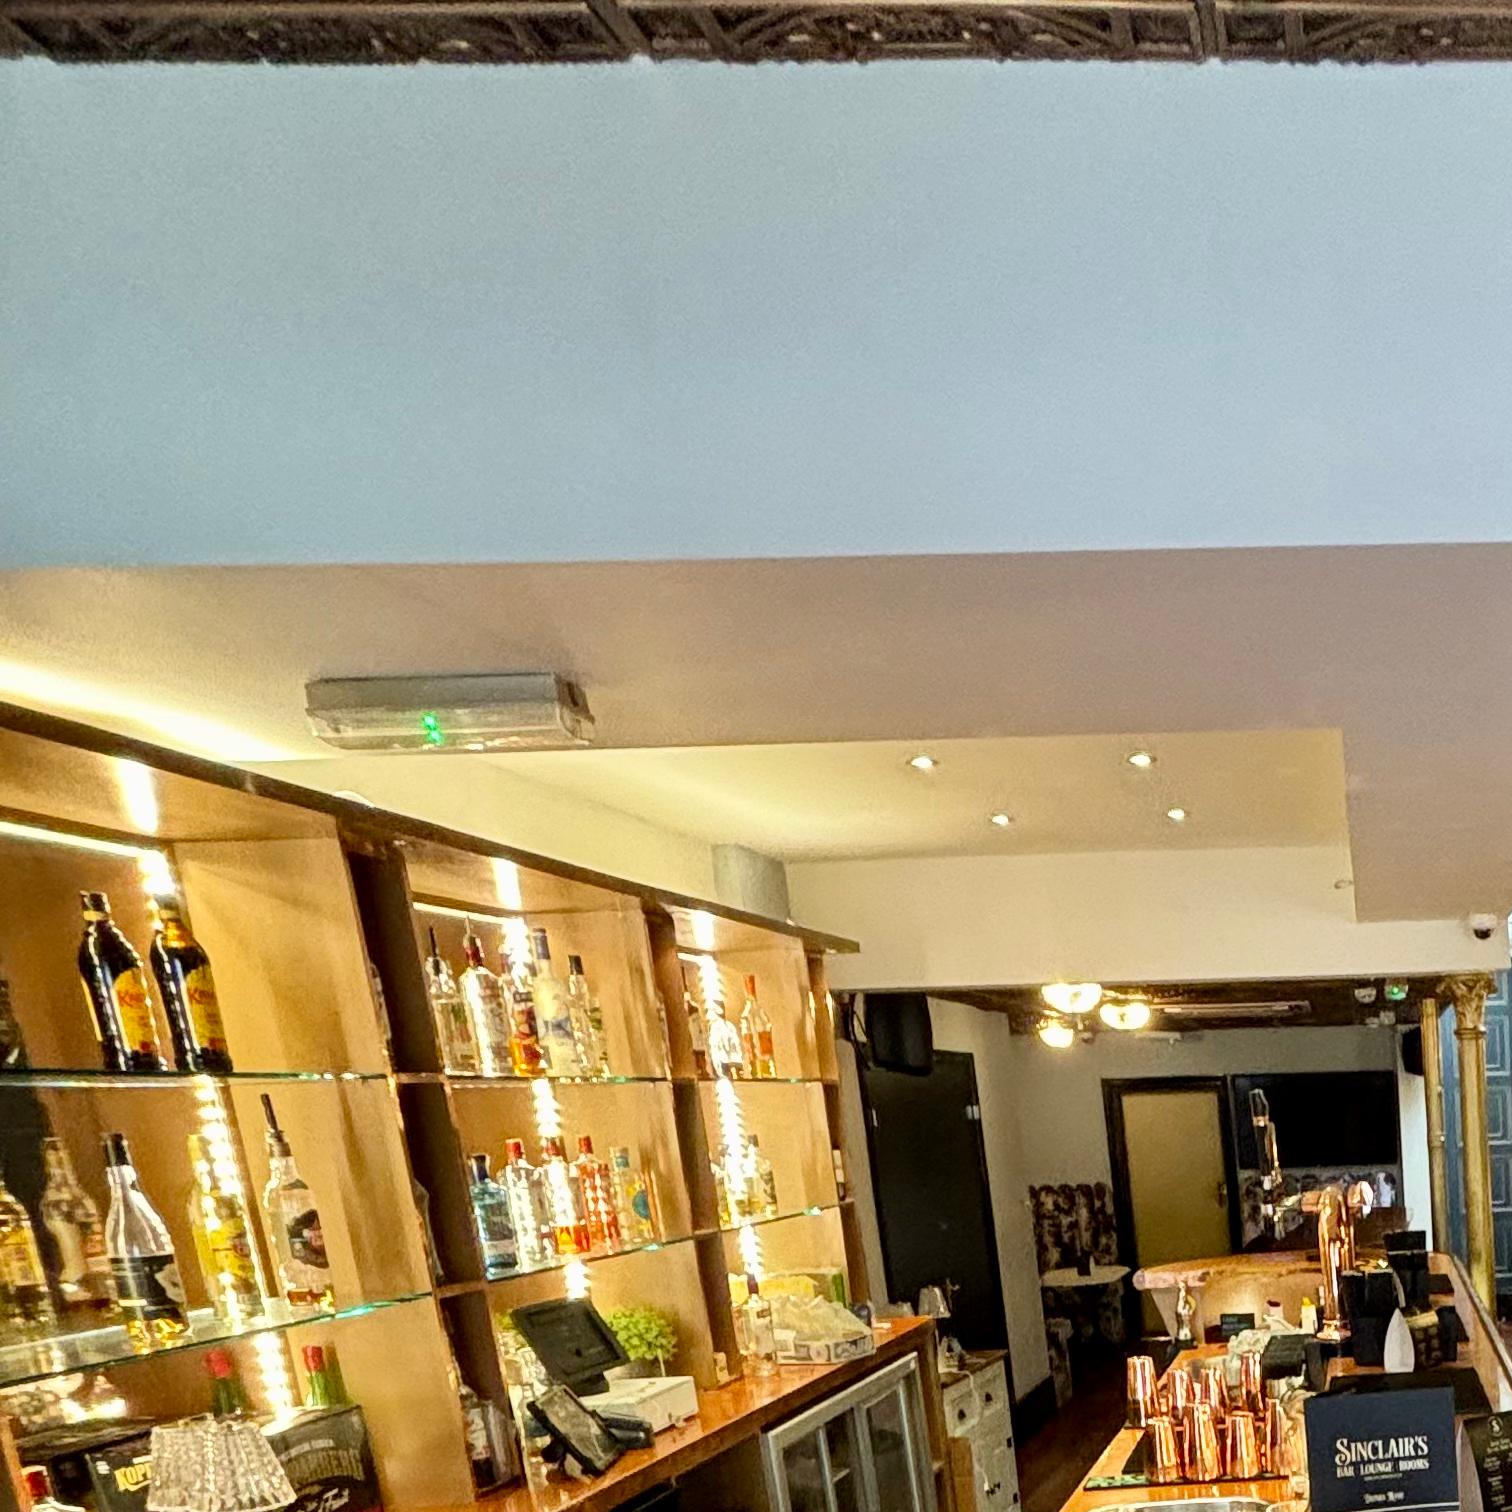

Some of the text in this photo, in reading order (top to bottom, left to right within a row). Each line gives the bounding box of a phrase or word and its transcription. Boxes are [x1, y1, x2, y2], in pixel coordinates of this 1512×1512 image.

[1335, 1435, 1429, 1466] SINCLAIR'S
[1360, 1461, 1395, 1476] LOUNGE
[1399, 1458, 1430, 1471] ROOMS
